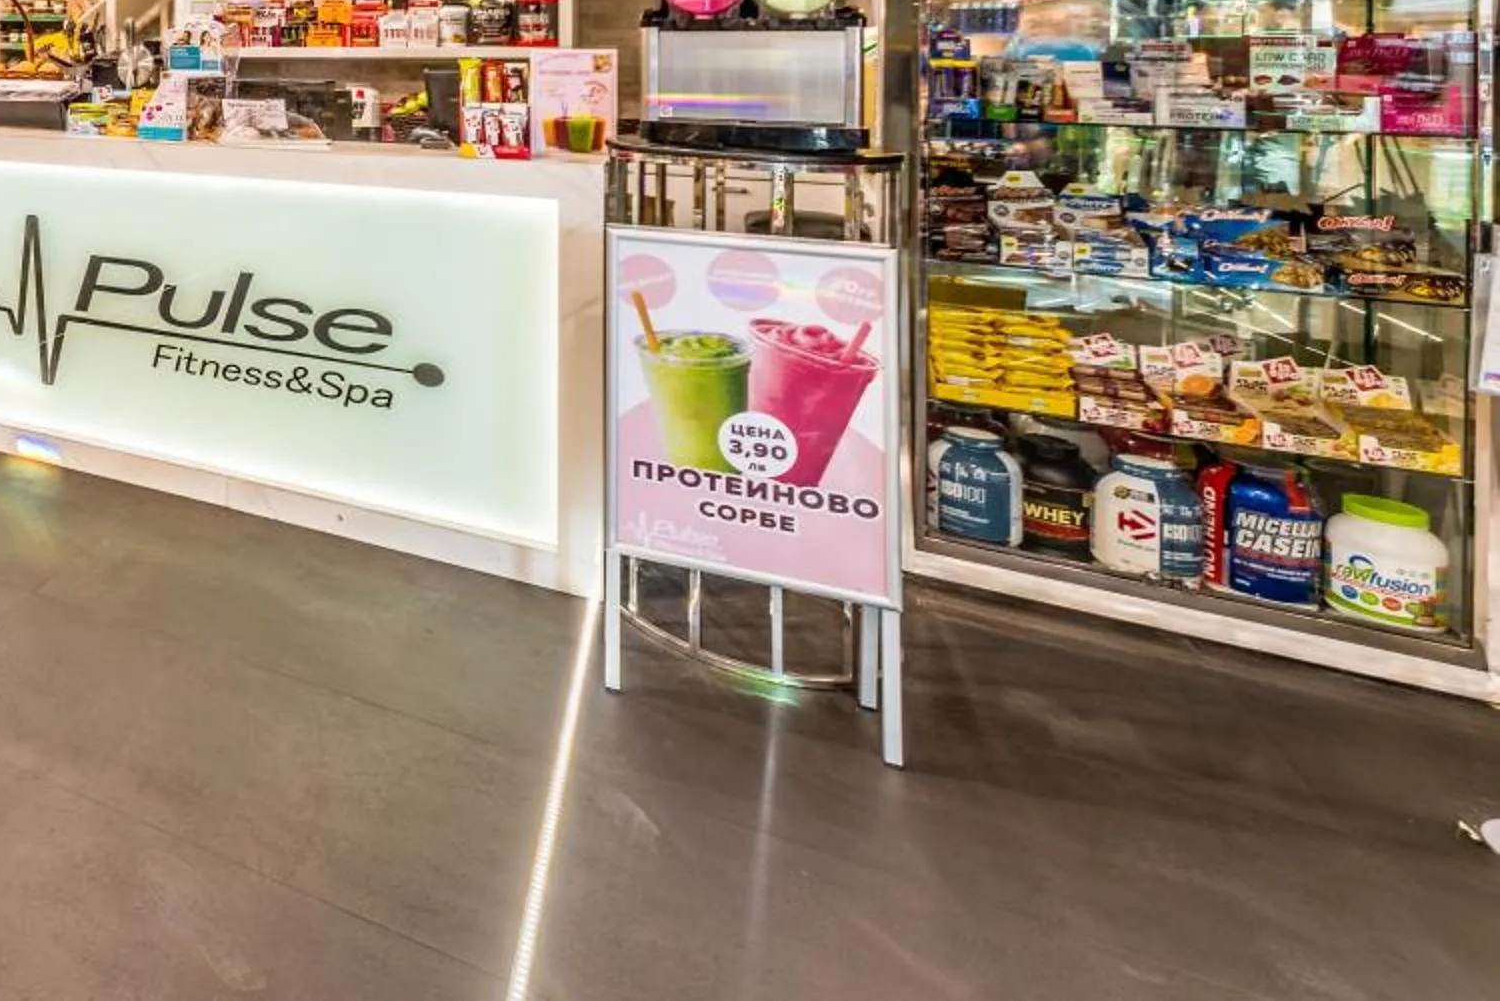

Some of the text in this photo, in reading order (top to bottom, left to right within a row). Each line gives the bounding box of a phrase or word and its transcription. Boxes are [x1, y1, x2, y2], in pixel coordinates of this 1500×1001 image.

[73, 254, 394, 355] Pulse
[152, 343, 395, 410] Fitness&Spa
[730, 422, 786, 441] ЦЕНА
[729, 439, 788, 461] 3,90
[632, 459, 880, 520] ПРОТЕИНОВО
[699, 500, 797, 534] СОРБЕ
[1023, 502, 1086, 527] WHEY
[1235, 529, 1322, 559] CASEIN
